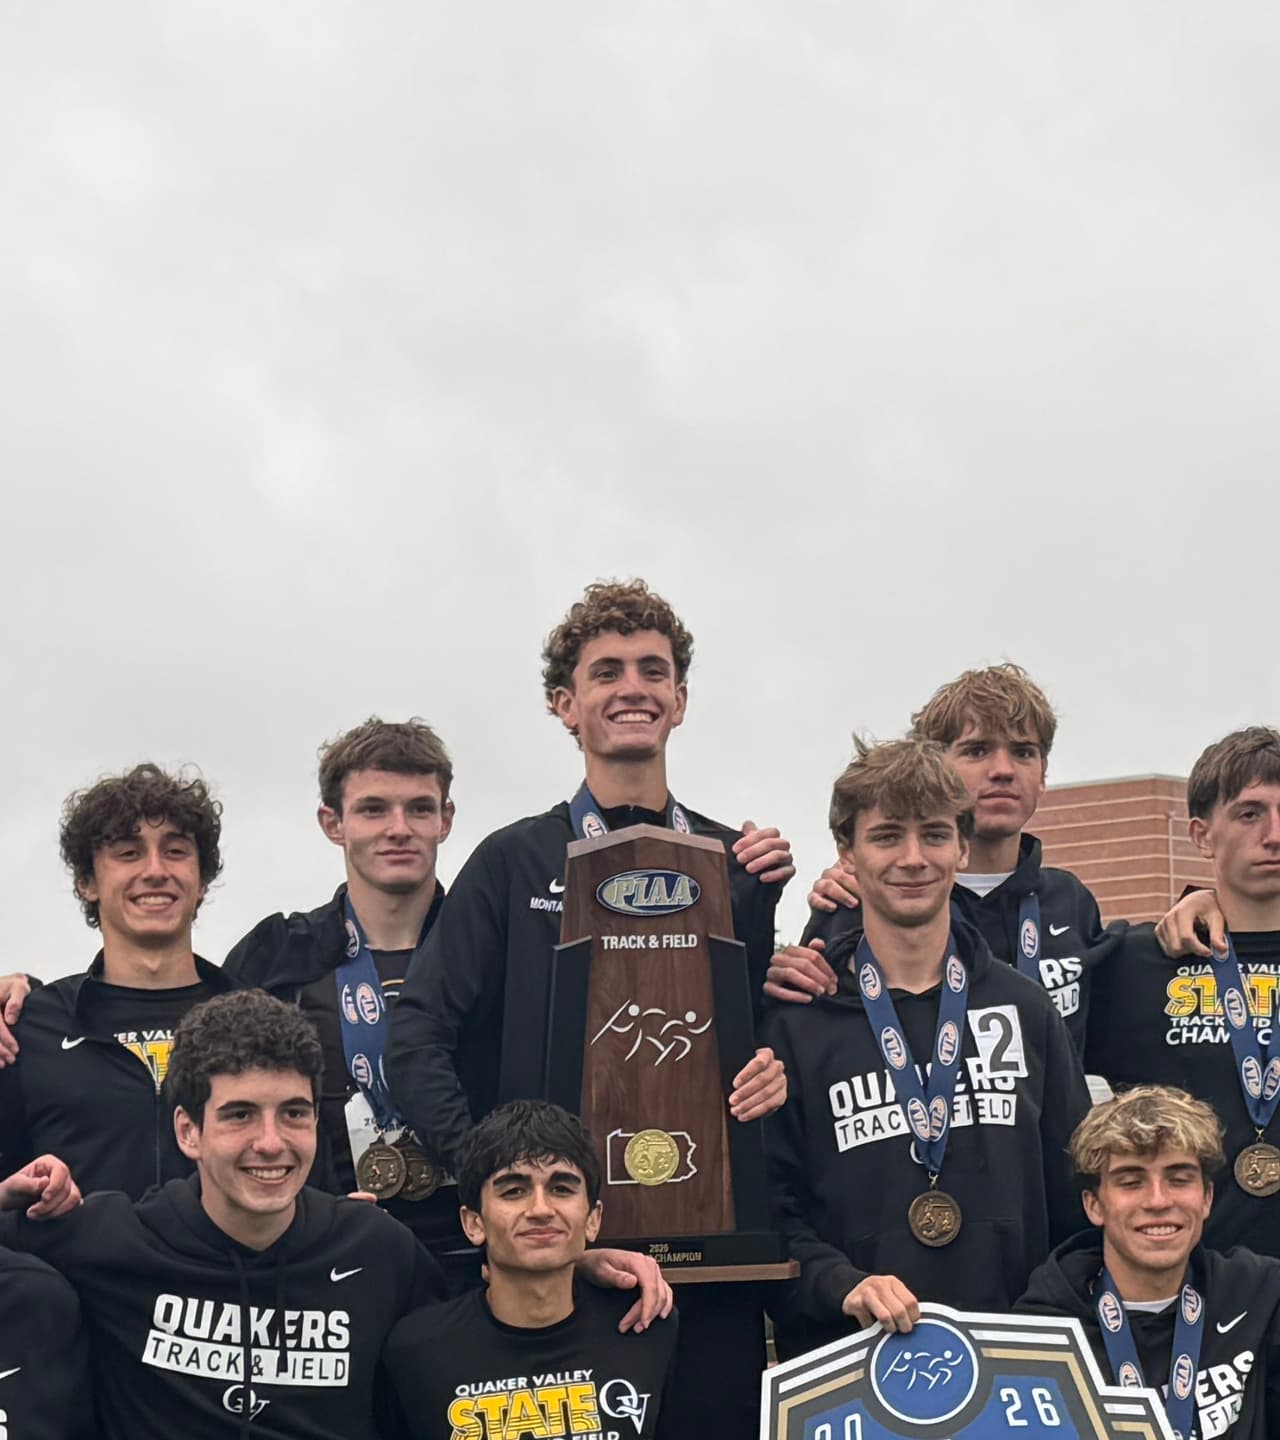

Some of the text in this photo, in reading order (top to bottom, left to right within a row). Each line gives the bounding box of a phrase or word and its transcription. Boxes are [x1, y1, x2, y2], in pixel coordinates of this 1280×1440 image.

[612, 876, 693, 907] PIAA
[601, 934, 698, 950] TRACK & FIELD
[1170, 1016, 1225, 1027] TRACK
[977, 1011, 1020, 1073] 2
[838, 1110, 902, 1145] TRAC
[153, 1293, 350, 1350] QUAKERS
[151, 1336, 241, 1376] TRACK
[252, 1354, 264, 1377] &
[455, 1369, 593, 1397] QUAKER VALLEY
[599, 1378, 651, 1435] QV
[1000, 1387, 1061, 1428] 26
